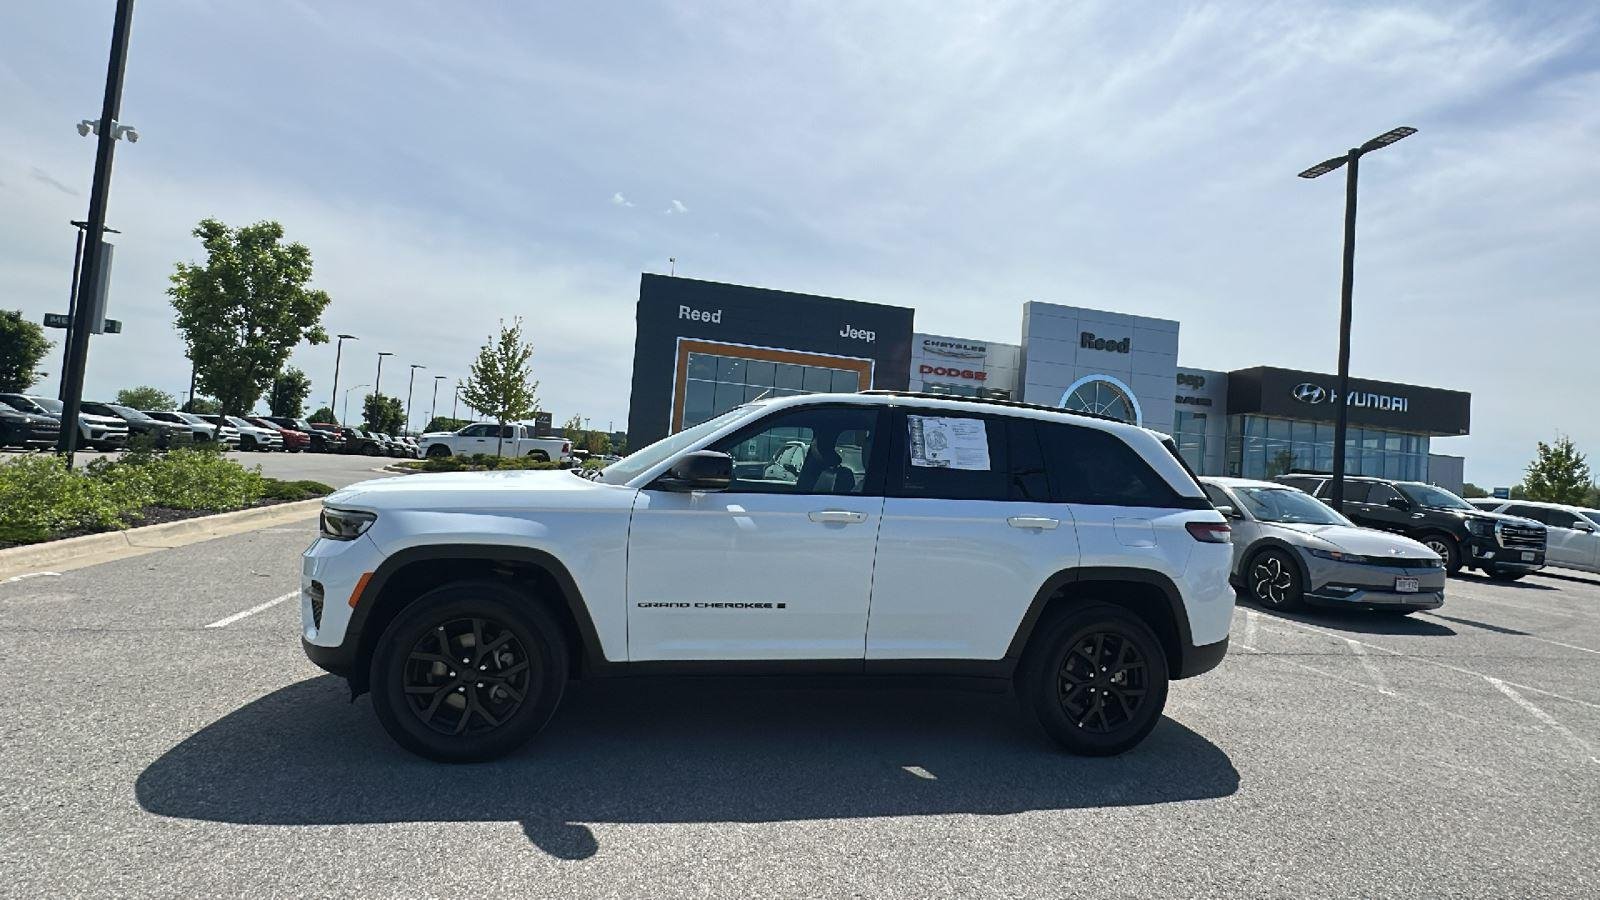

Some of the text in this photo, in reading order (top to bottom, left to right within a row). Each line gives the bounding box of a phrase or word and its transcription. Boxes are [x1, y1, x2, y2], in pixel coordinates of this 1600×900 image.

[678, 304, 722, 323] Reed
[839, 325, 876, 342] Jeep
[923, 339, 986, 352] CHRYSLER
[1080, 332, 1131, 354] Reed
[919, 364, 987, 381] DODGE
[1330, 388, 1408, 412] HYUNDAI
